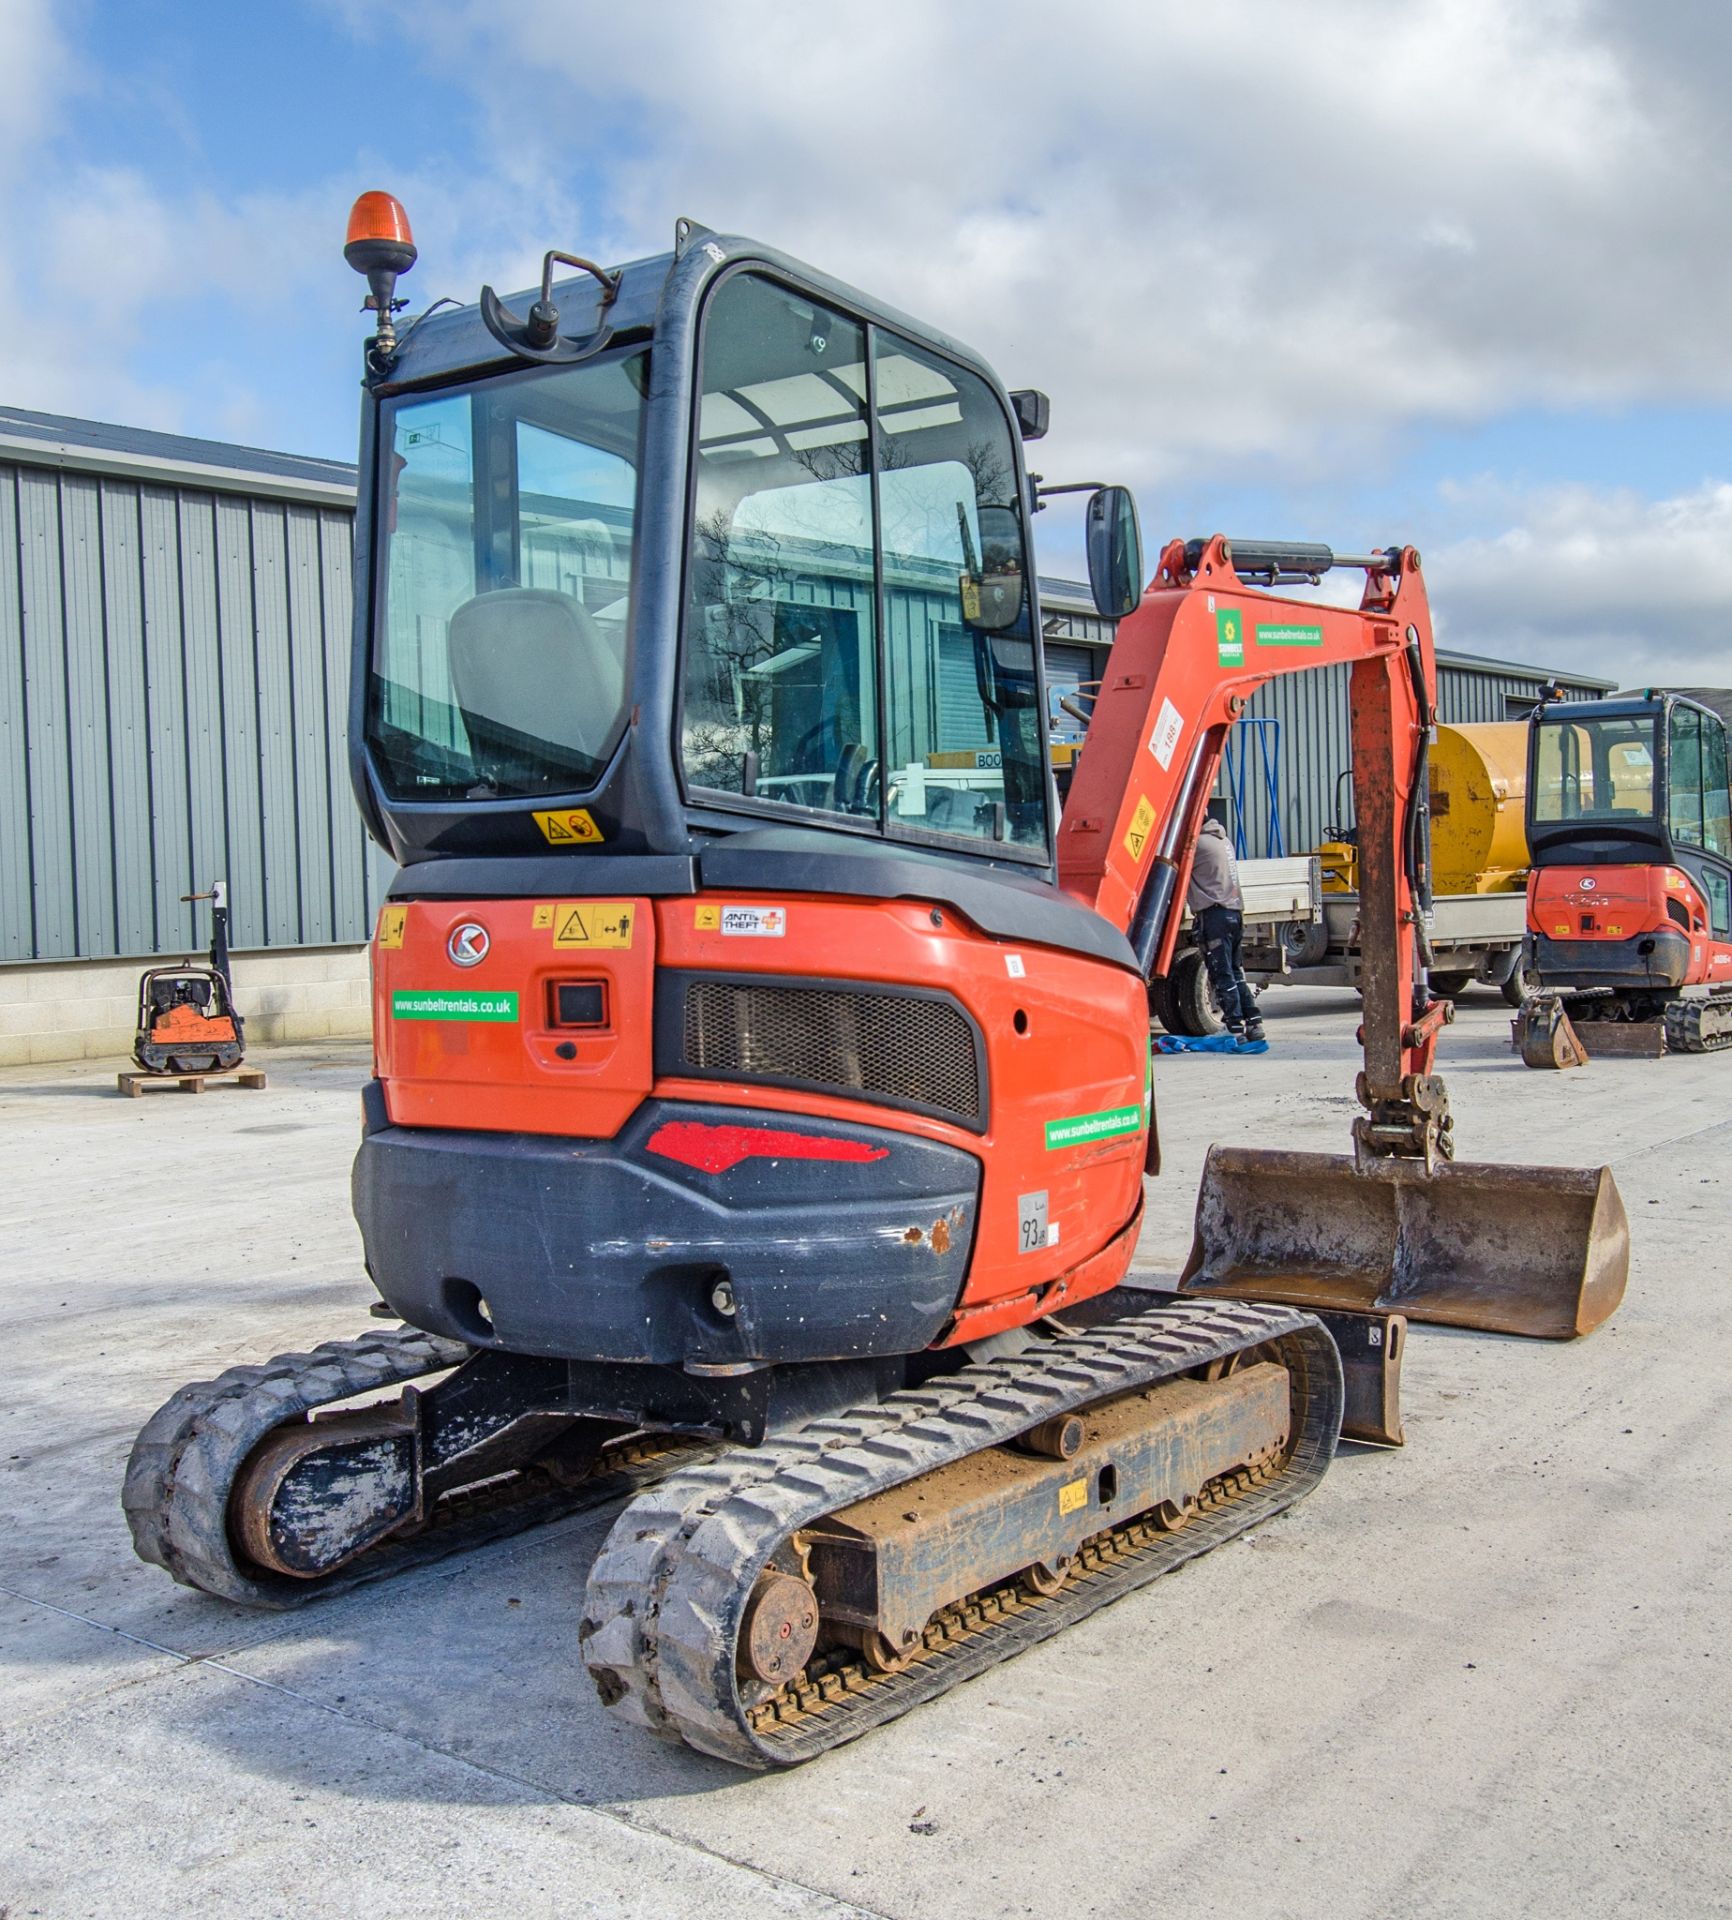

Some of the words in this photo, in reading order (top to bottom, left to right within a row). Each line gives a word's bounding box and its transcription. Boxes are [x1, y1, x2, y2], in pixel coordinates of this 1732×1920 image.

[724, 921, 759, 929] THEFT
[395, 997, 511, 1013] www.sunbeltrentals.co.uk
[1049, 1111, 1139, 1142] www.sunbeltrentals.co.uk
[1022, 1218, 1038, 1249] 93
